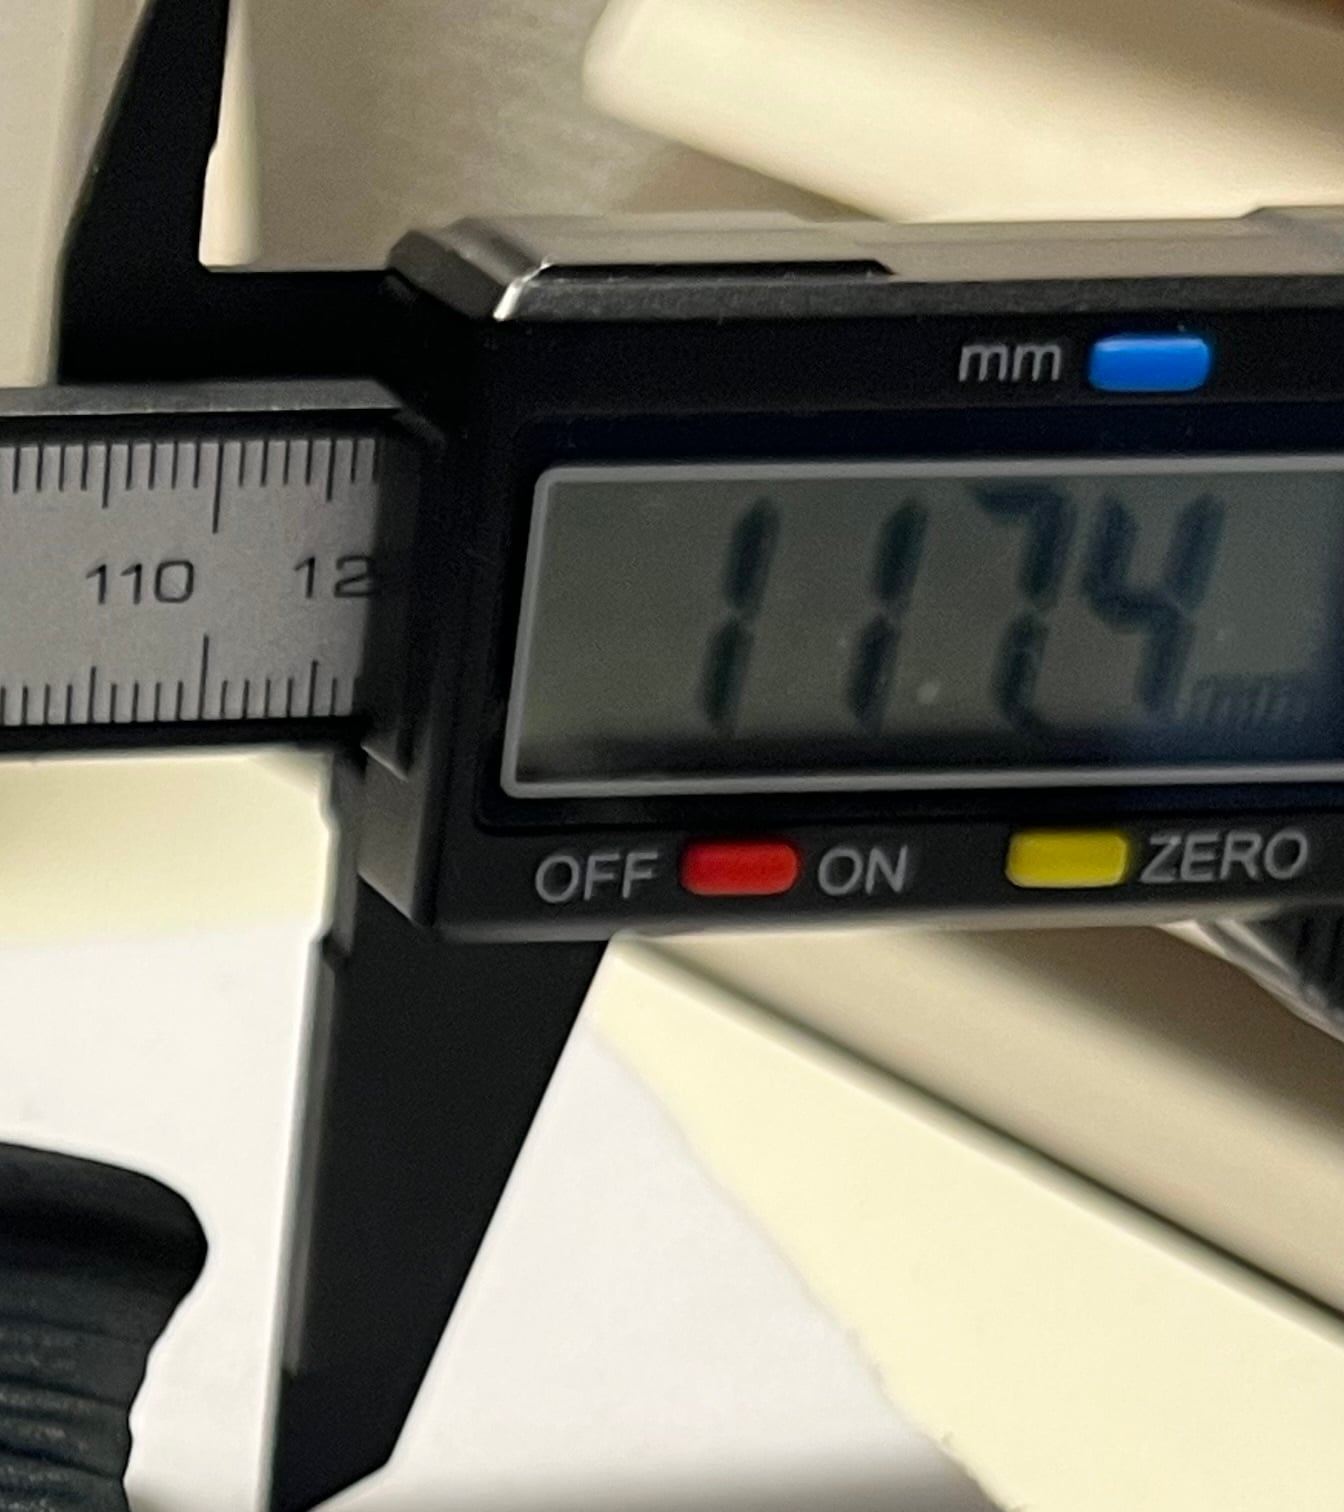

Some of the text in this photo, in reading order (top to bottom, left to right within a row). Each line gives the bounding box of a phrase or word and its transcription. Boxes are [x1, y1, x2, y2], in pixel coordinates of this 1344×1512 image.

[958, 343, 1062, 382] mm
[86, 559, 196, 605] 110
[292, 554, 380, 600] 12
[535, 845, 909, 903] OFF ON
[1139, 828, 1310, 884] ZERO
